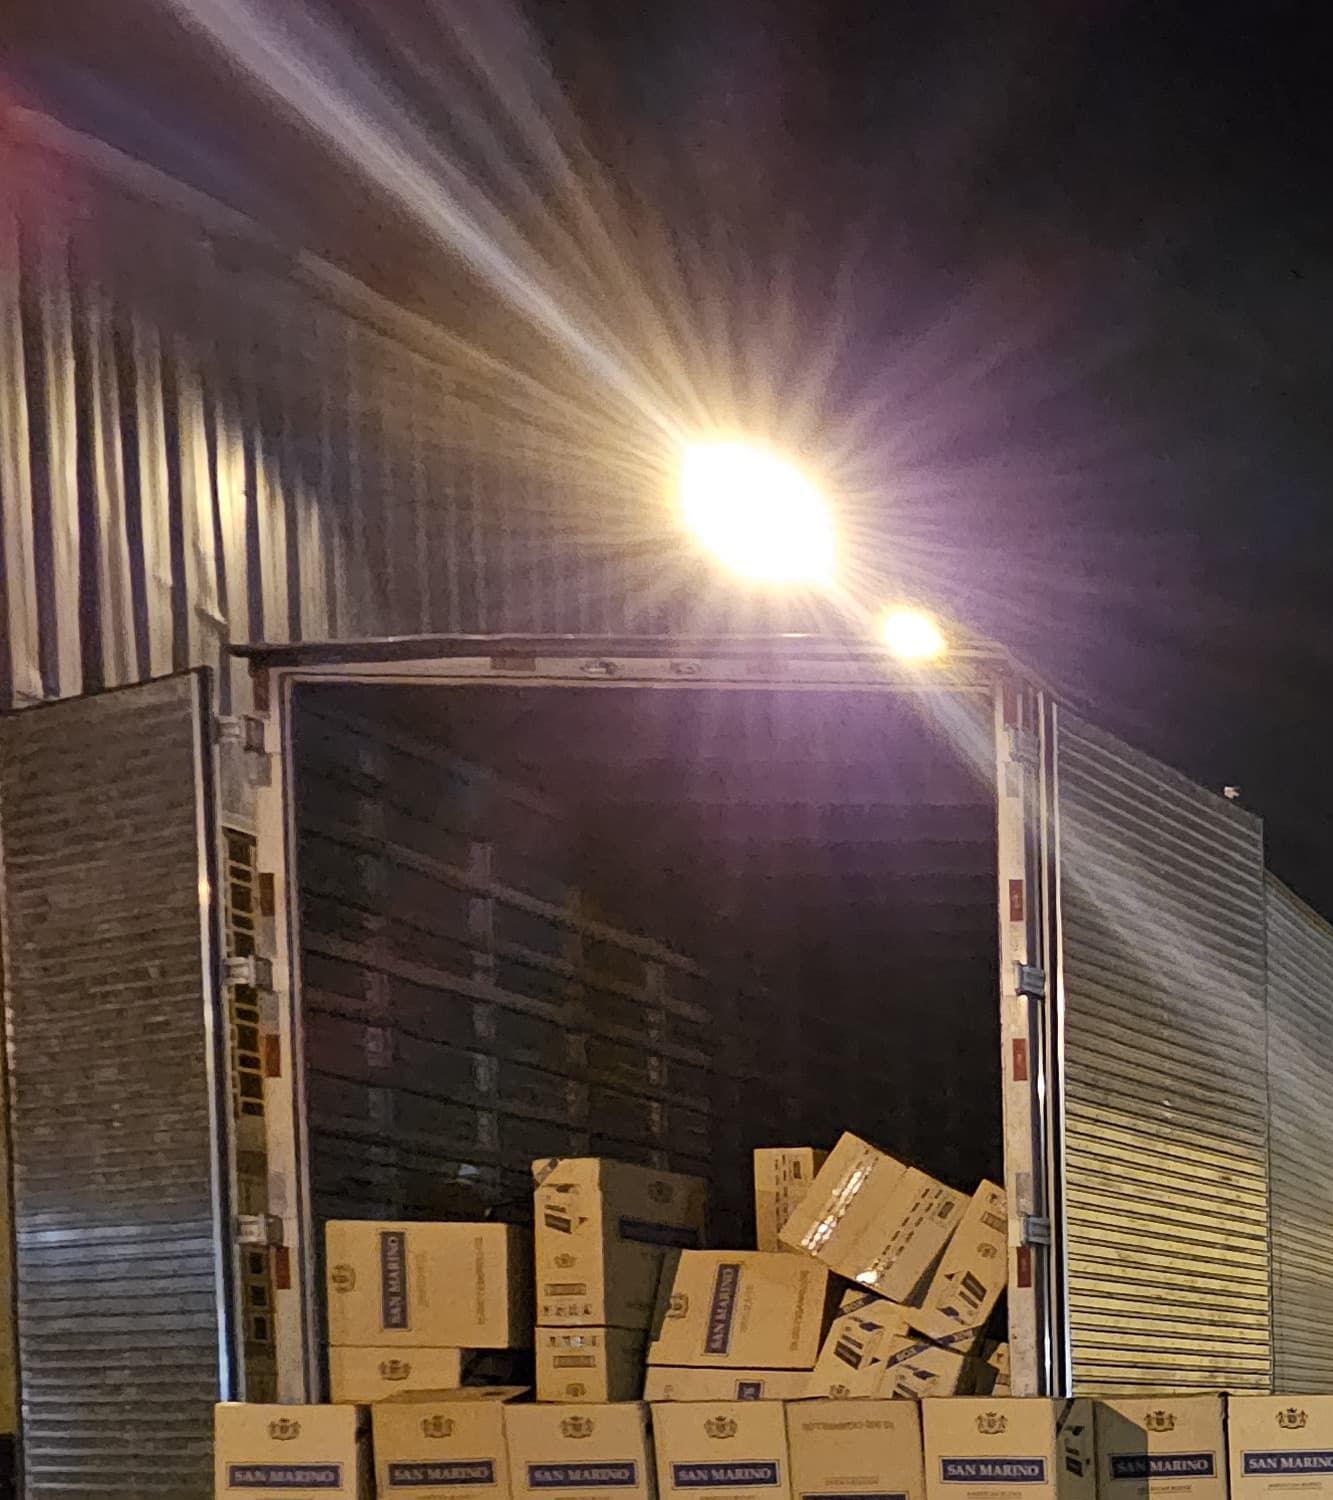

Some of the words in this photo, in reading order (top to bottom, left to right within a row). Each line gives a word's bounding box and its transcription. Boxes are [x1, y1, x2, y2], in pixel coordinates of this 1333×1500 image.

[1249, 1457, 1277, 1470] SAN
[947, 1464, 976, 1476] SAN
[980, 1464, 1038, 1476] MARINO
